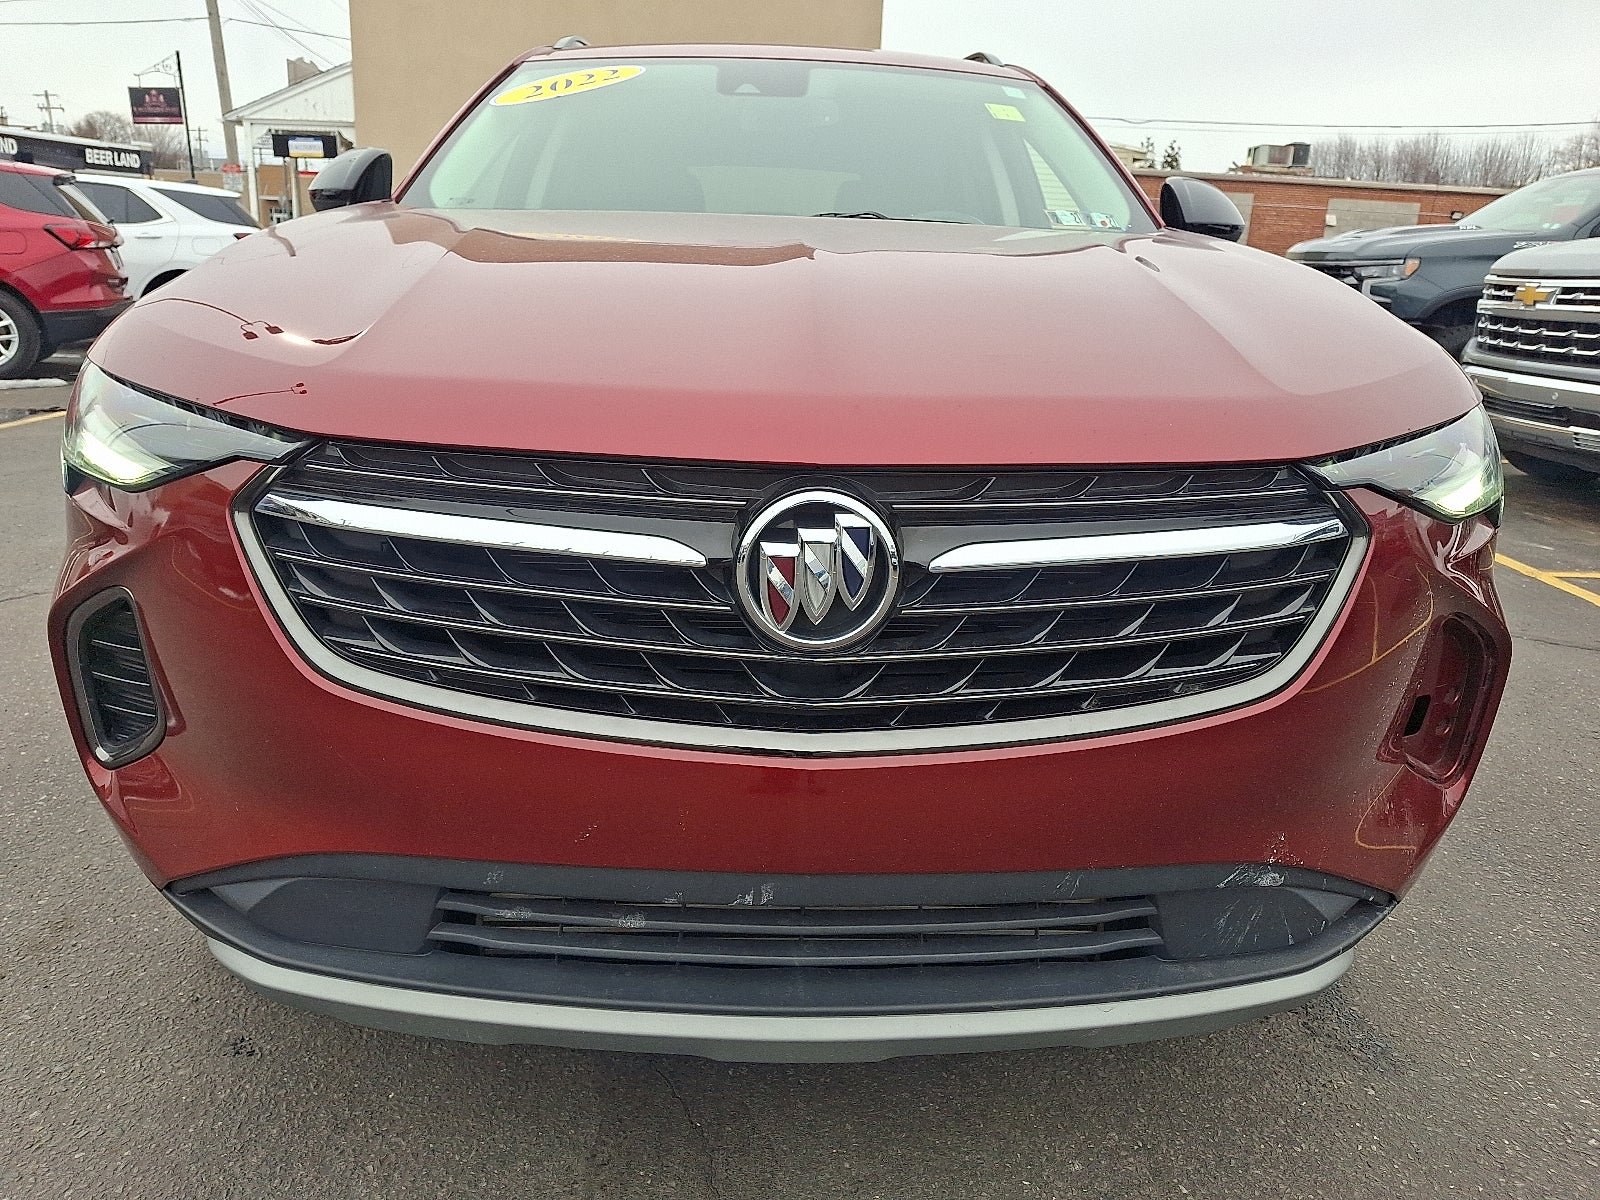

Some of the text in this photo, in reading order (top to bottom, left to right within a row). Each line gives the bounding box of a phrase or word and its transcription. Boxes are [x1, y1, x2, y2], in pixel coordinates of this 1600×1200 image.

[525, 69, 621, 99] 2022
[85, 147, 141, 169] BEER LAND
